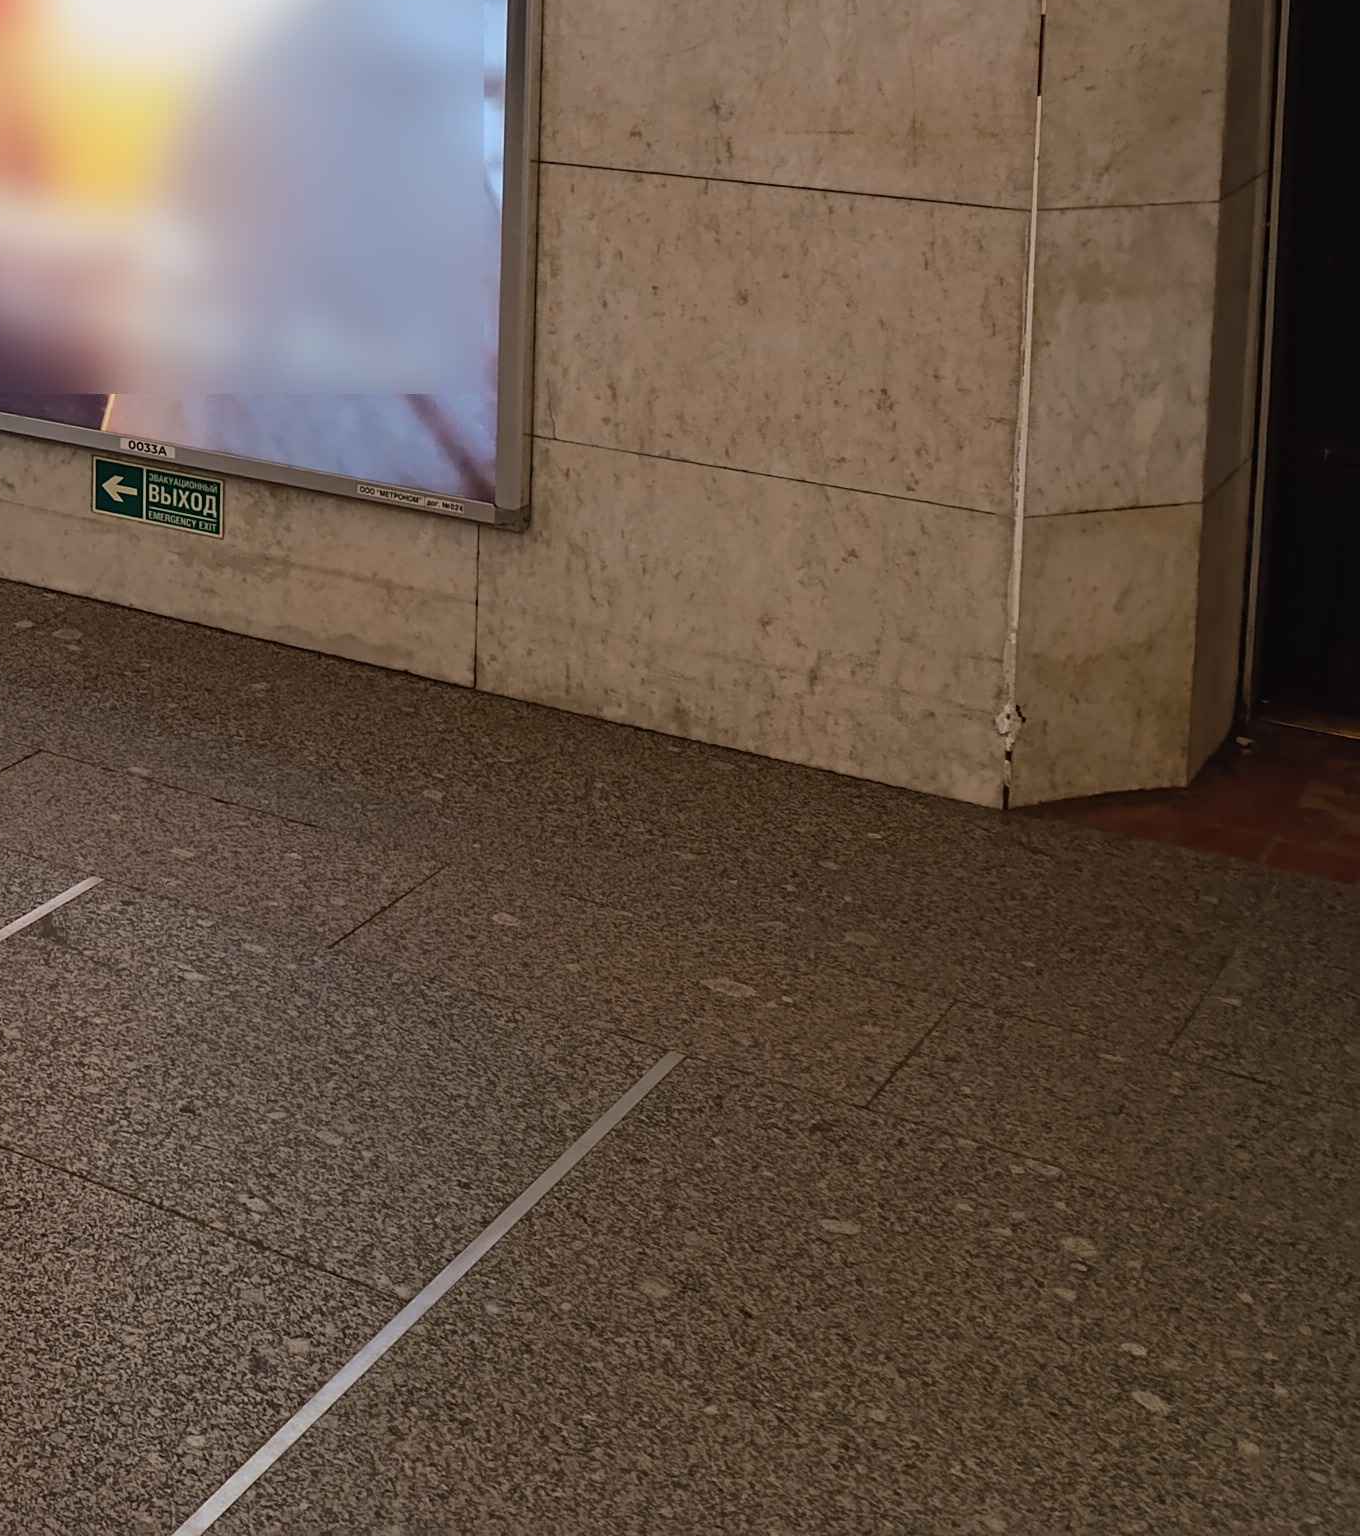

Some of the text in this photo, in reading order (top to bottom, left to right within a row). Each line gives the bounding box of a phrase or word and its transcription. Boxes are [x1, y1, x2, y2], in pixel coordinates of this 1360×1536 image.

[148, 483, 217, 518] ВЫХОД
[148, 510, 217, 532] EMERGENCY EXIT
